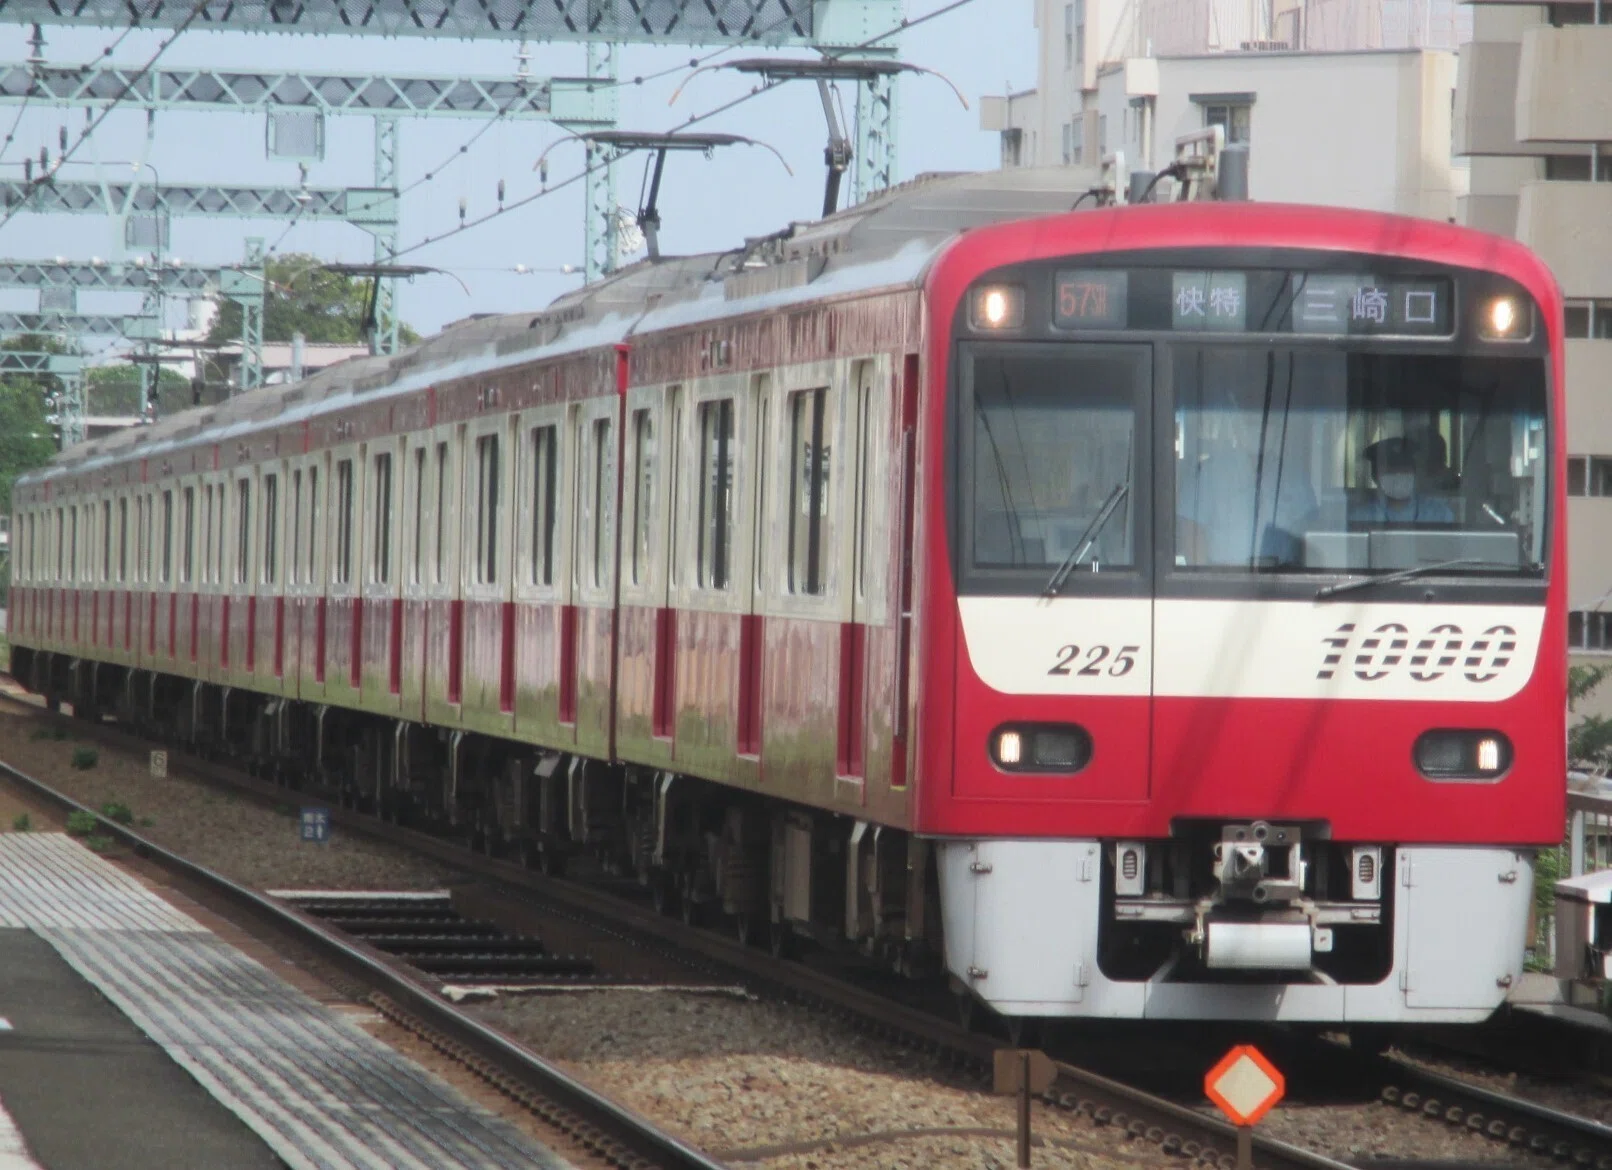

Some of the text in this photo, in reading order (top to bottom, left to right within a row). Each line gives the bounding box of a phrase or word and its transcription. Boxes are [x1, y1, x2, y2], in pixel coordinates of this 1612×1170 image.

[1175, 286, 1241, 317] 快特
[1302, 287, 1436, 324] 三崎口
[1047, 645, 1140, 677] 225
[1316, 623, 1517, 683] 1000
